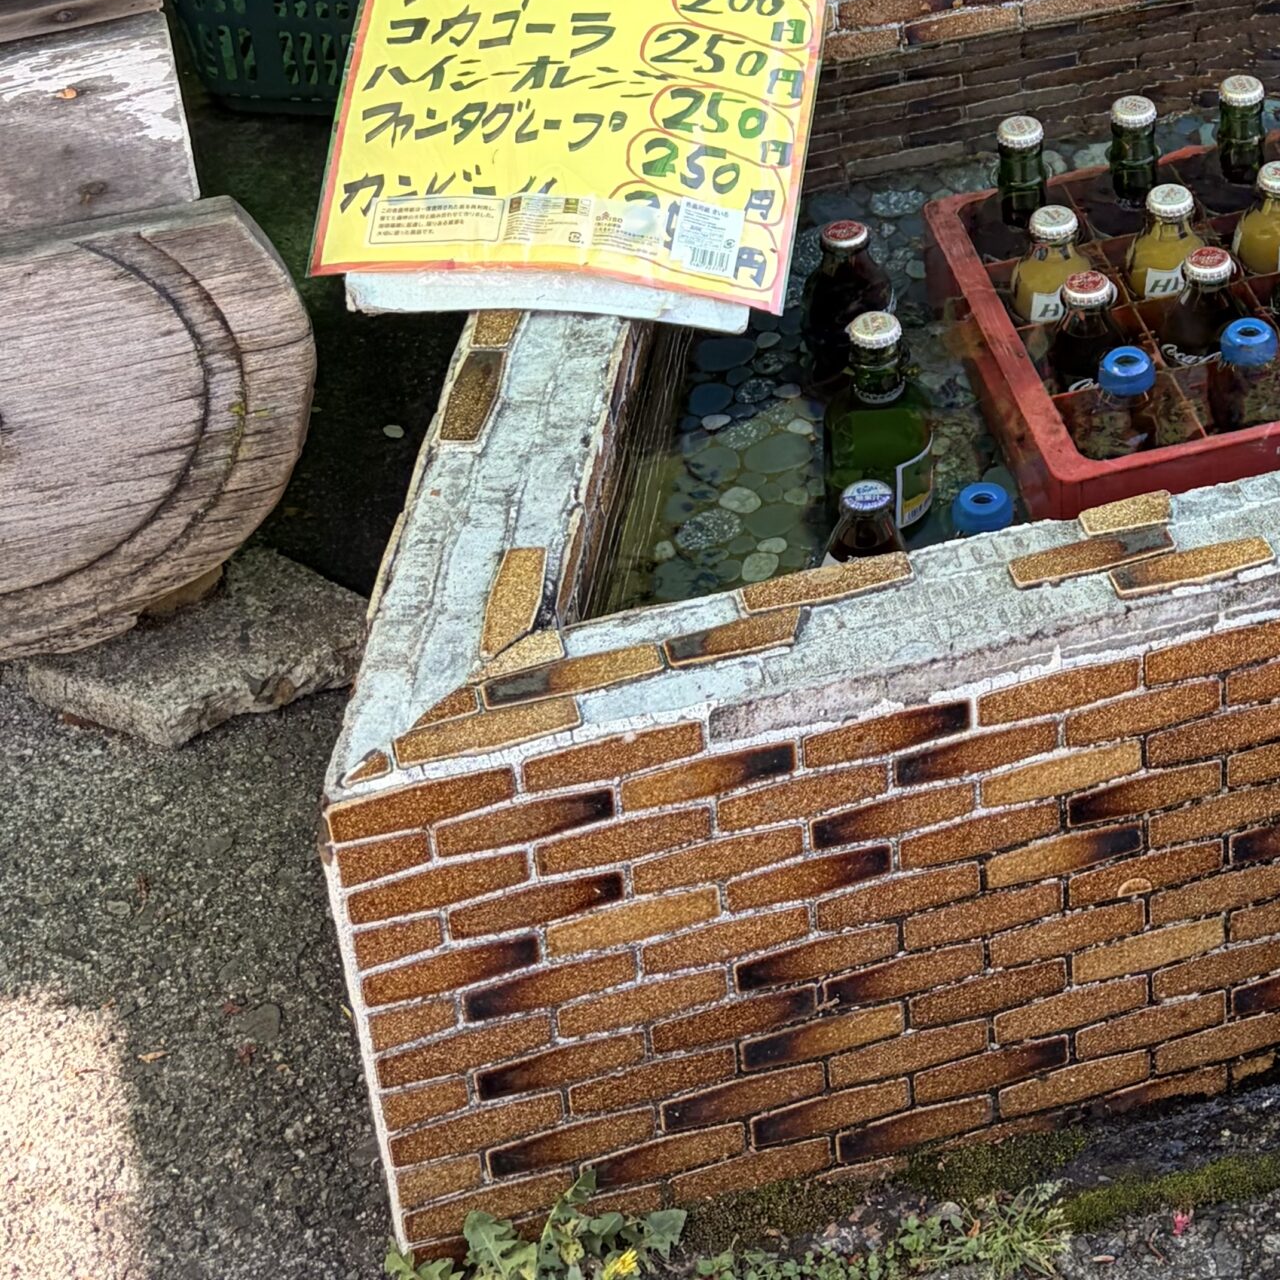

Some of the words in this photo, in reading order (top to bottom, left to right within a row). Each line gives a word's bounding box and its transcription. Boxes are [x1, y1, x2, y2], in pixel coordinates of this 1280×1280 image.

[386, 6, 617, 58] コカコーラ
[361, 99, 629, 153] ファンタグレープ
